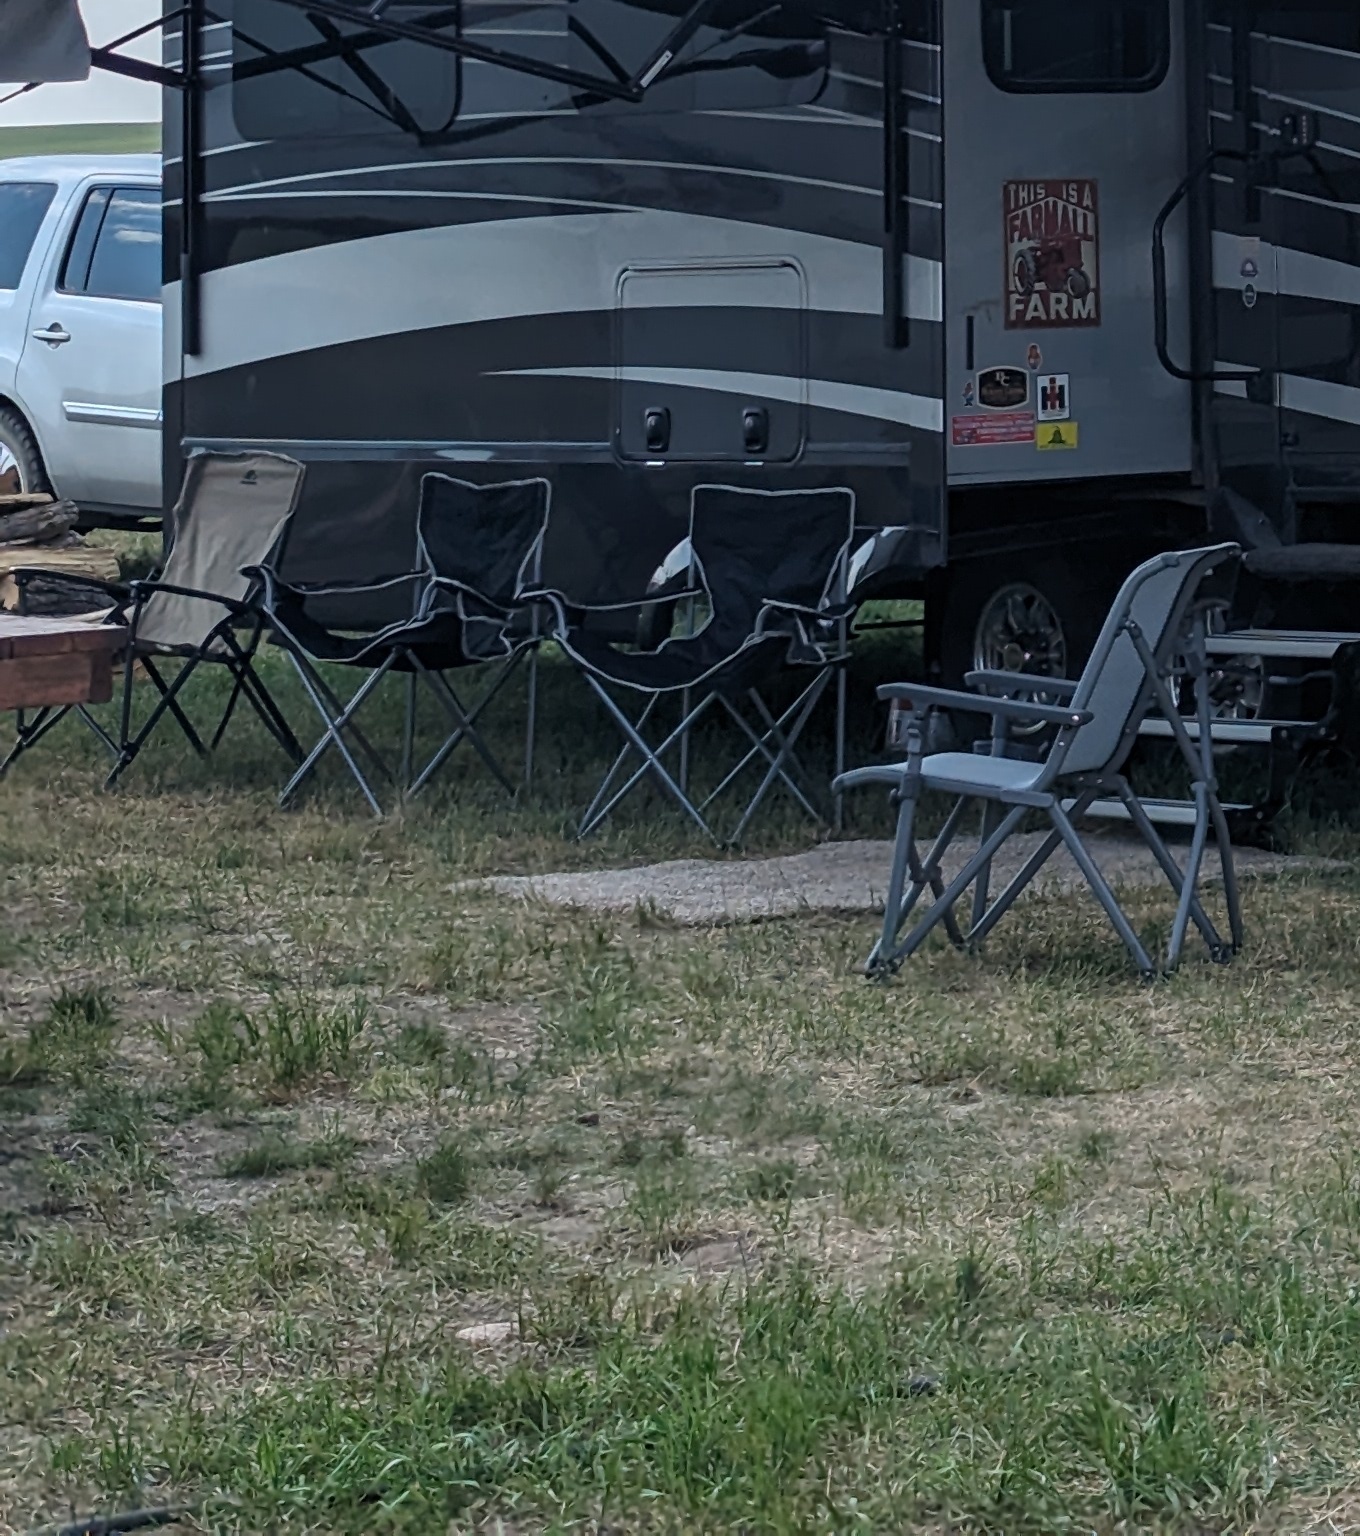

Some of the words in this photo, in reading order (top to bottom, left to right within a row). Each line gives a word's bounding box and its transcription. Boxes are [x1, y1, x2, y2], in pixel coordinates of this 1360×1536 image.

[1008, 182, 1046, 209] THIS
[1062, 182, 1078, 204] IS
[1082, 182, 1094, 209] A
[1008, 291, 1098, 322] FARM
